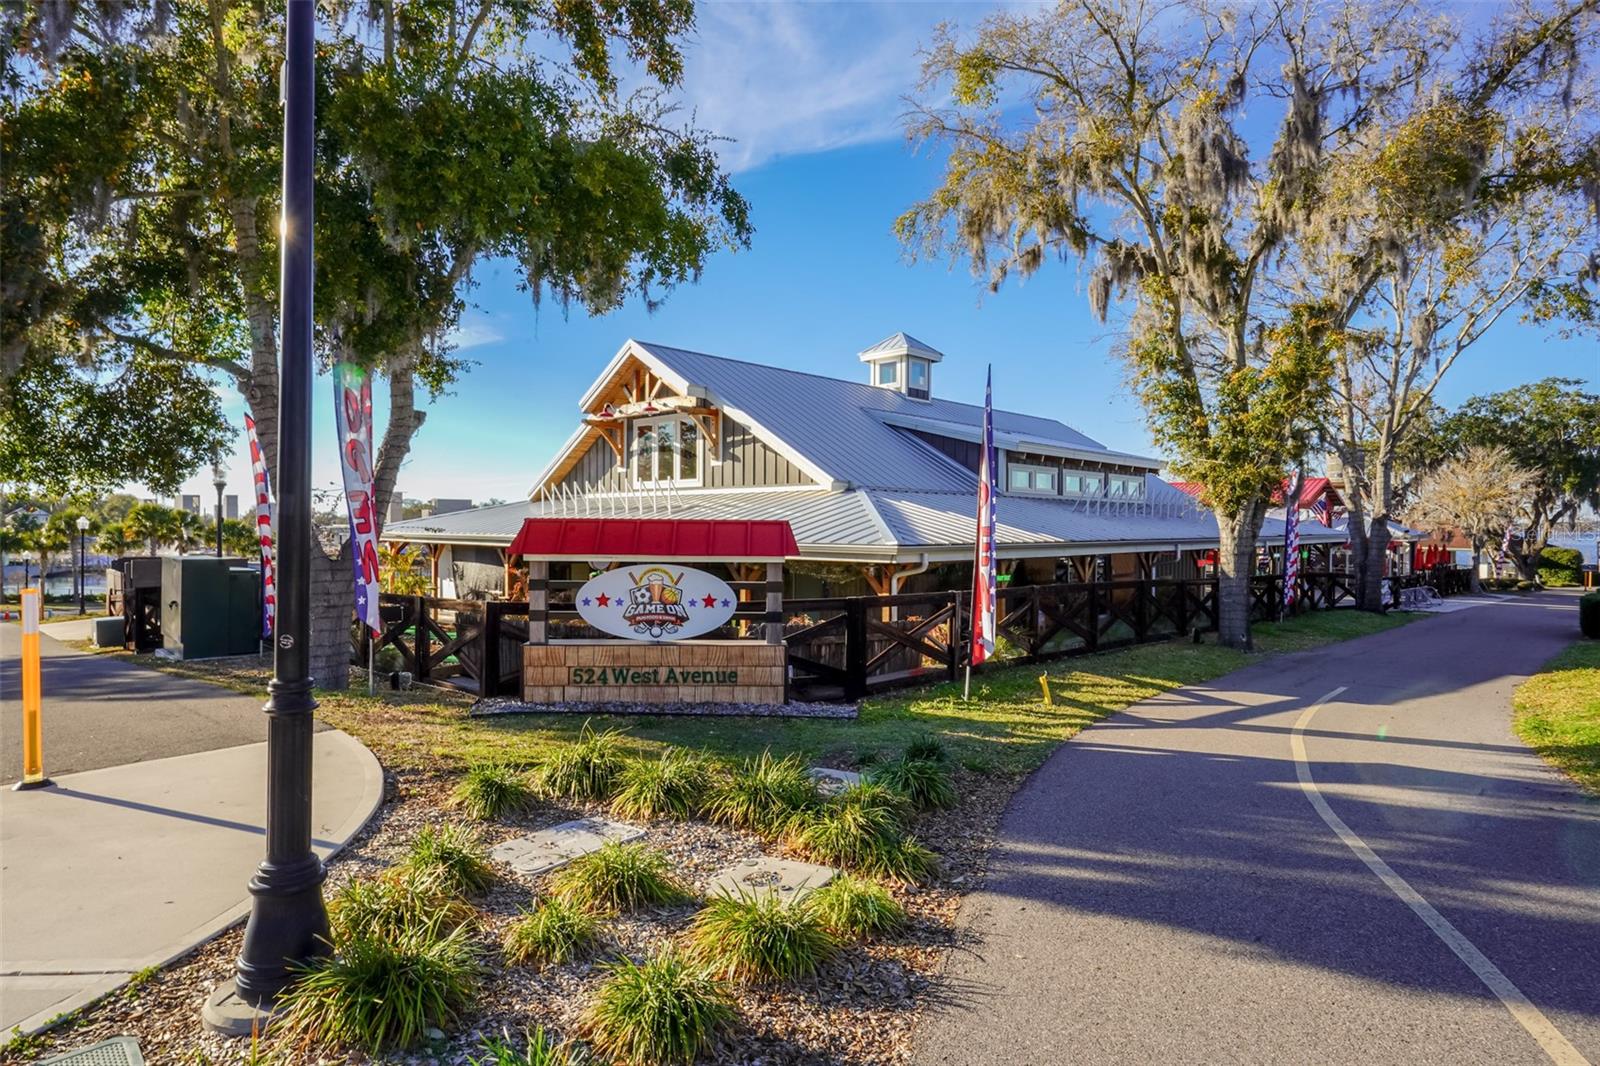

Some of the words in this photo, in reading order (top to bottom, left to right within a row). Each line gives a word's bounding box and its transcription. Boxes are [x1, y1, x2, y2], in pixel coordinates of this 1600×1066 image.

[624, 604, 665, 617] GAME
[666, 604, 688, 618] ON
[573, 668, 609, 685] 524
[612, 668, 660, 684] West
[665, 668, 738, 684] Avenue
